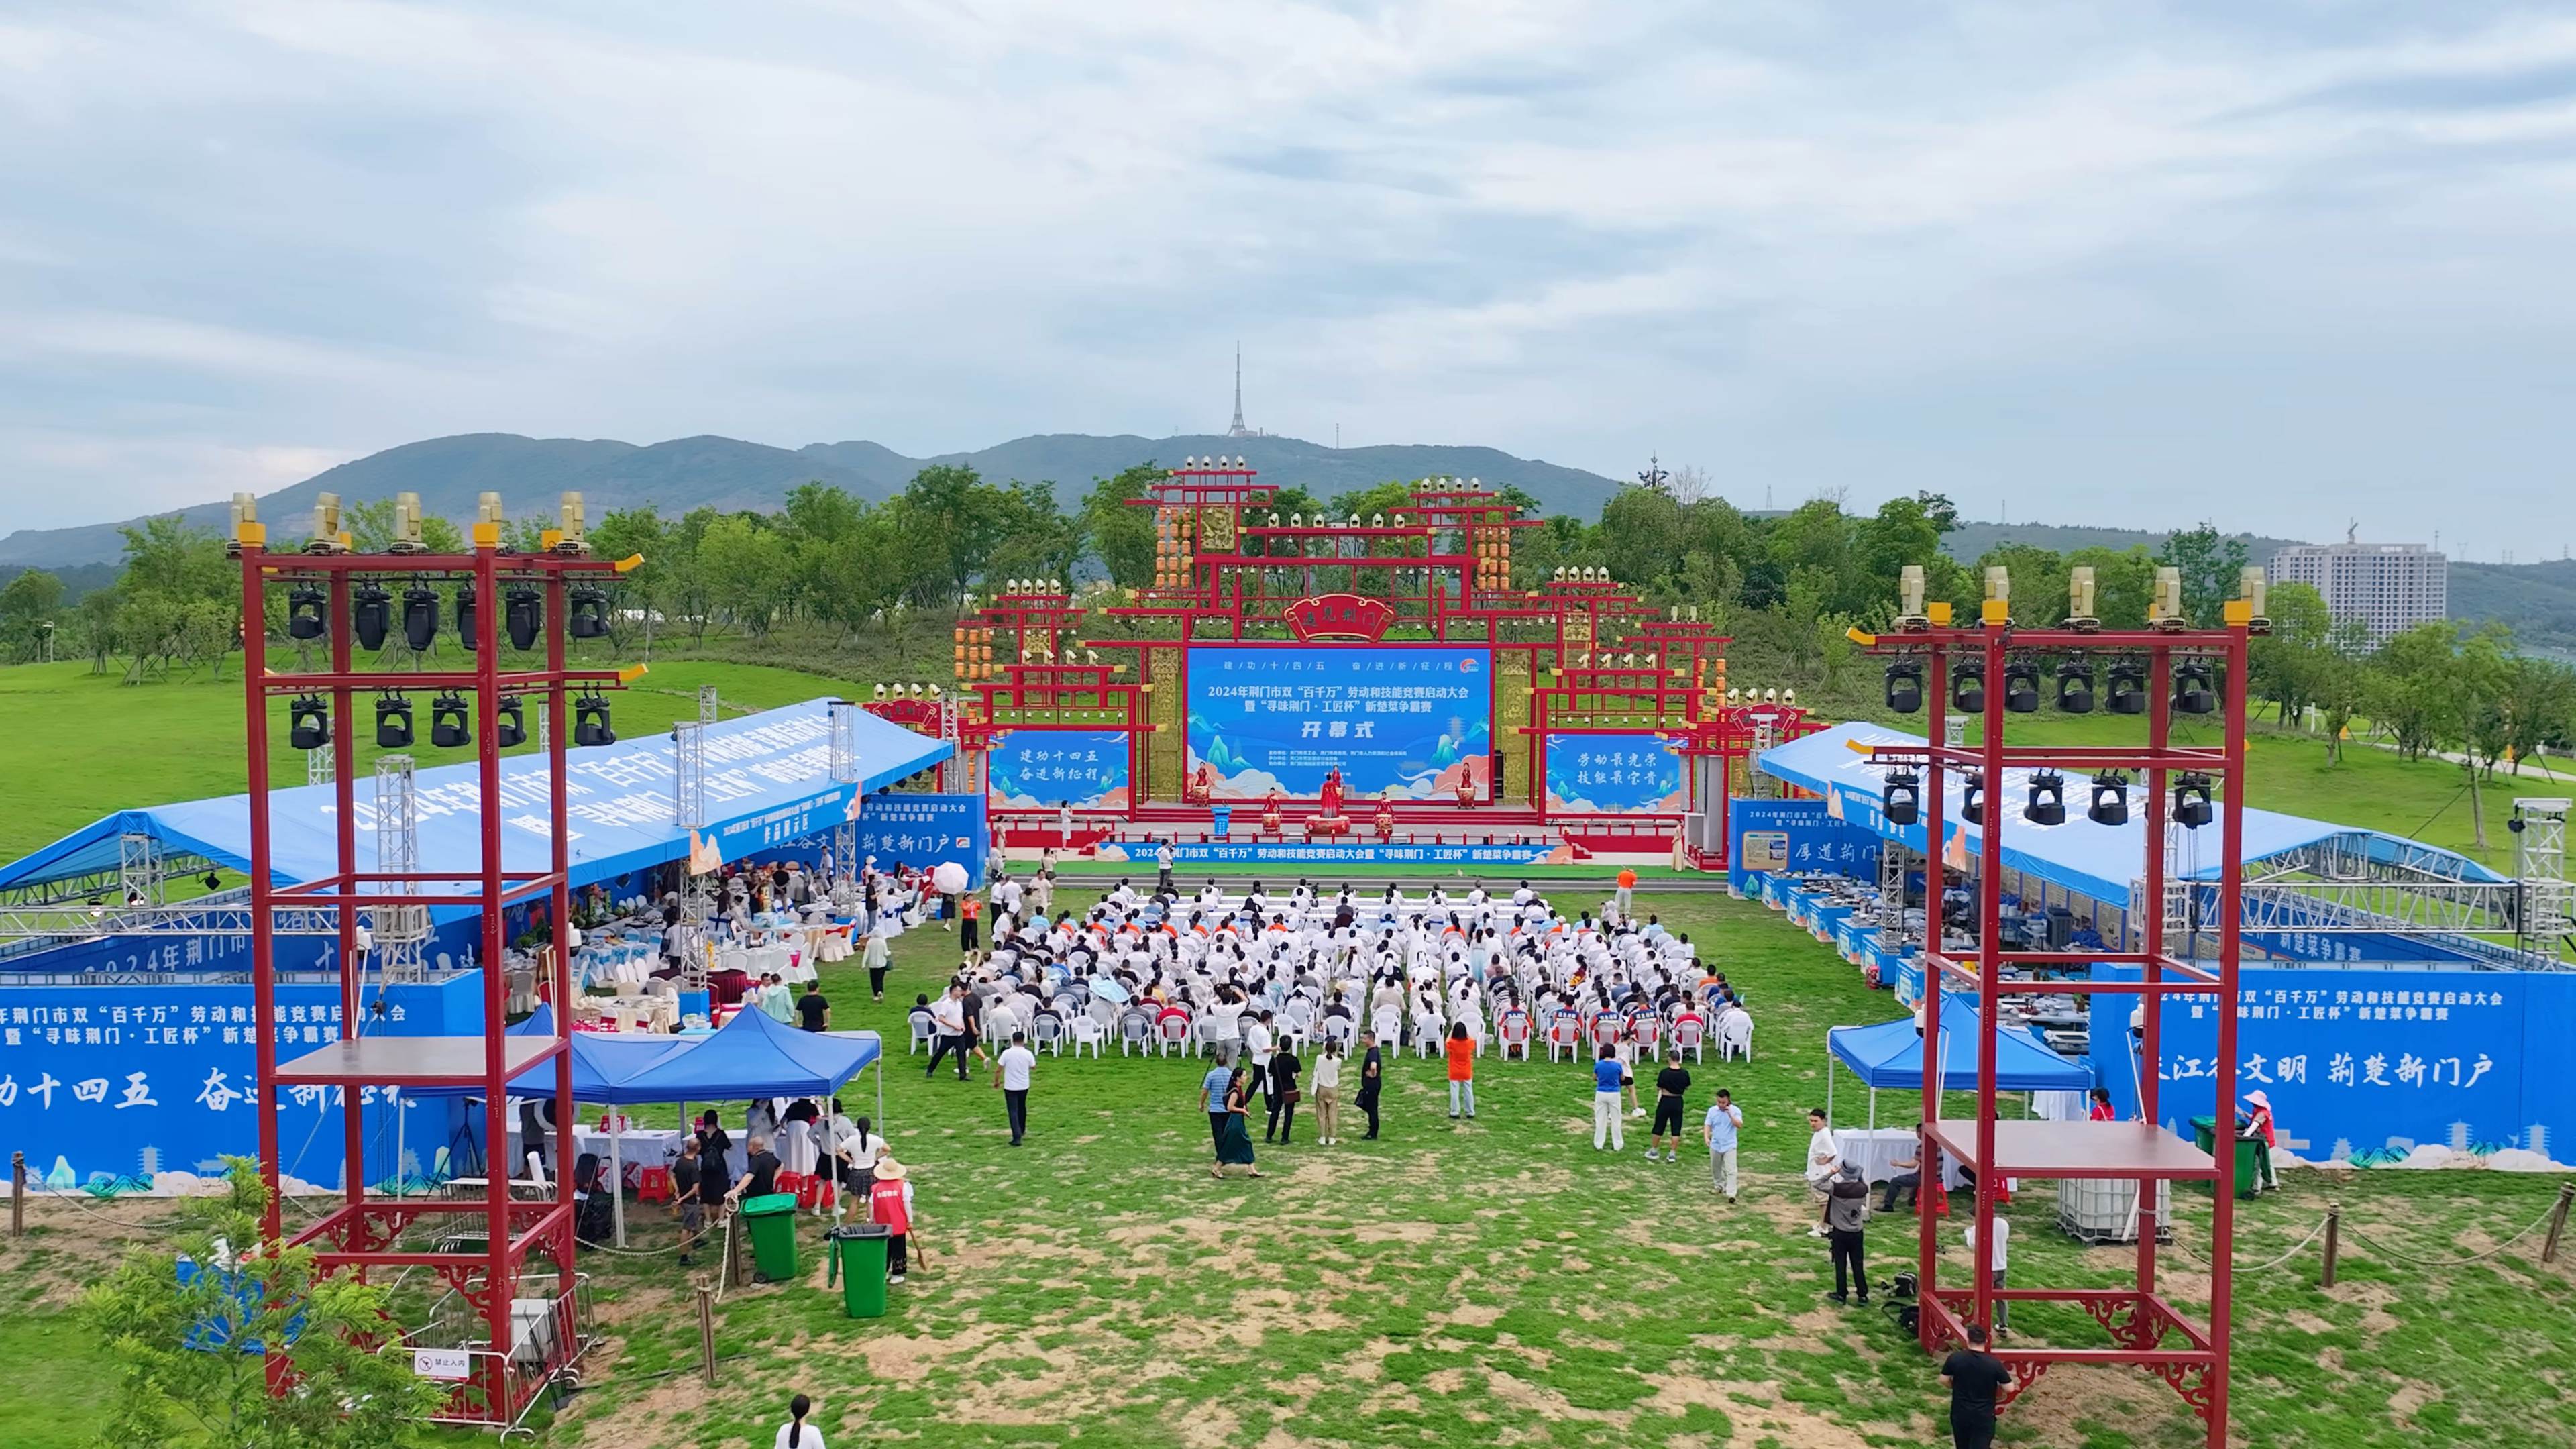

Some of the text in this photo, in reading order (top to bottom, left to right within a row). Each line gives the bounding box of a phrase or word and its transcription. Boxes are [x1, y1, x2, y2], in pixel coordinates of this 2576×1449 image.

[1208, 686, 1469, 699] 2024年荆门市双“百千万”劳动和技能竞赛启动大会
[1301, 720, 1375, 739] 开幕式
[1020, 748, 1099, 763] 建功十四五
[1578, 752, 1657, 767] 劳动最光荣
[1019, 767, 1097, 782] 奋进新征程
[1577, 771, 1657, 786] 技能最宝贵
[861, 833, 950, 854] 荆楚新门户
[1795, 842, 1878, 862] 厚道荆门
[2327, 1051, 2494, 1089] 荆楚新门户
[435, 1358, 465, 1367] 禁止入内
